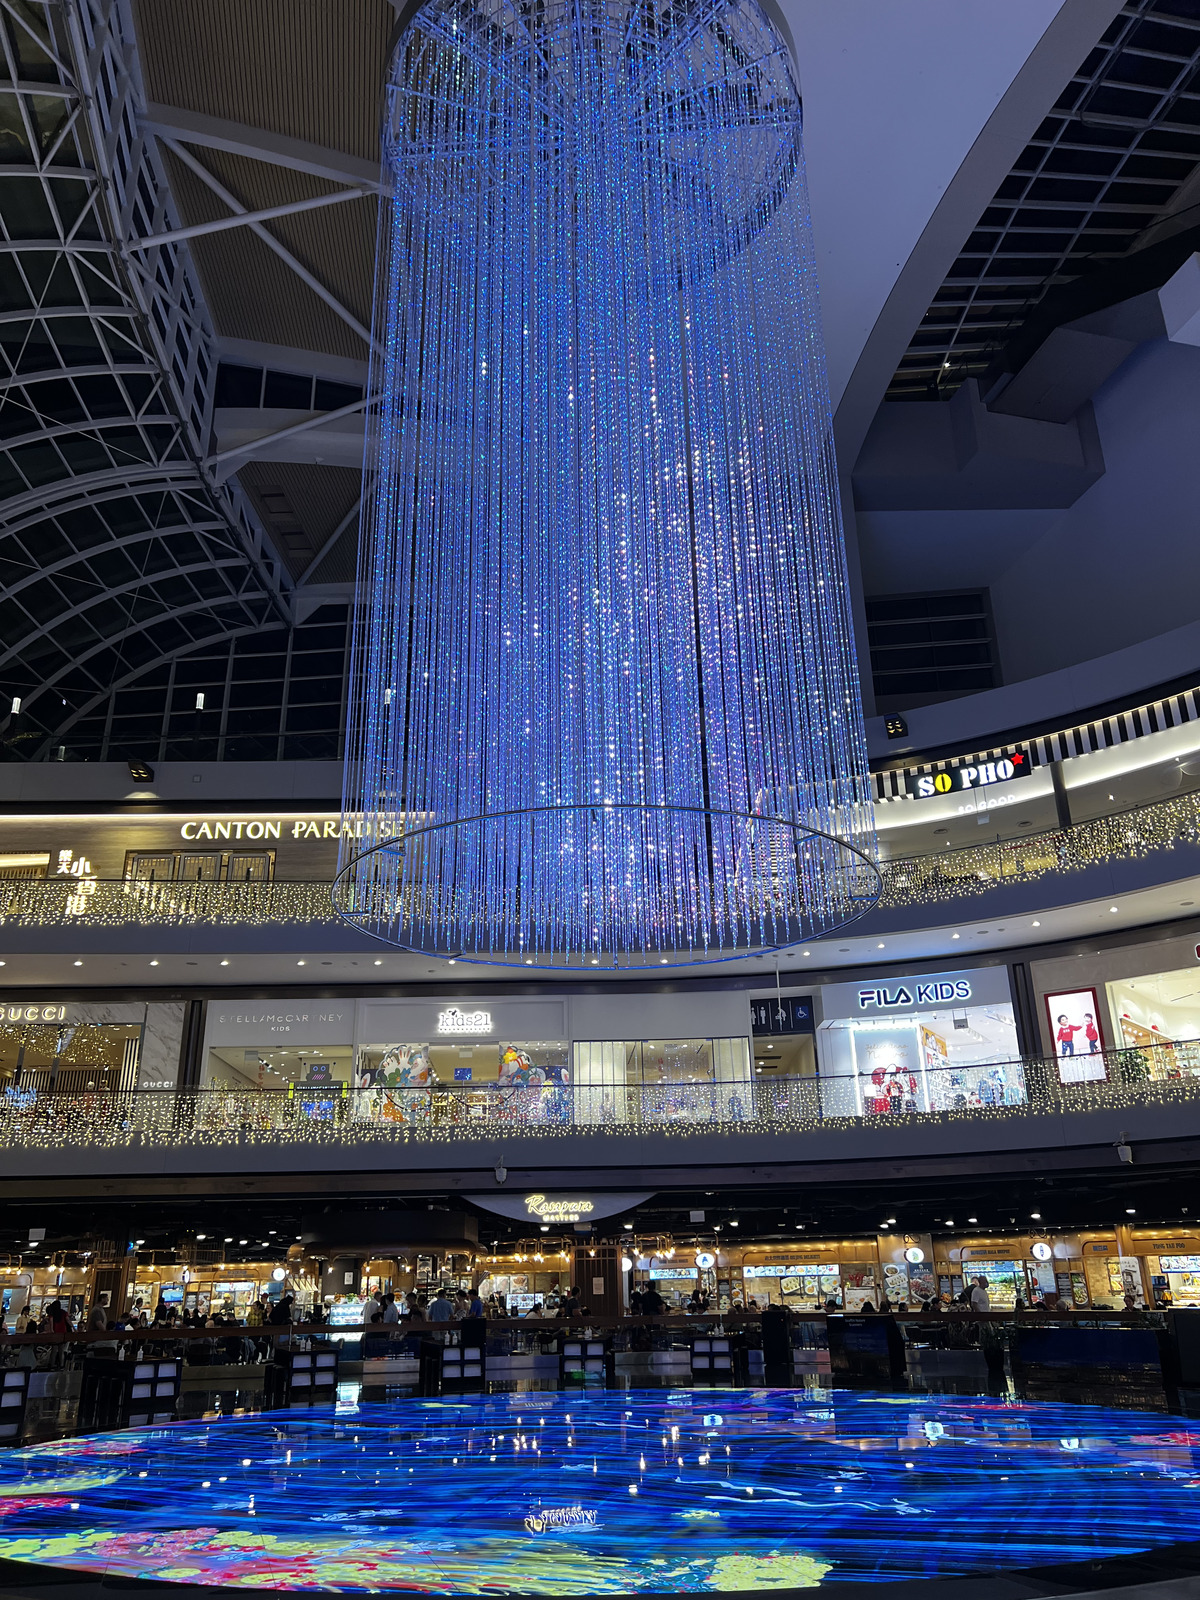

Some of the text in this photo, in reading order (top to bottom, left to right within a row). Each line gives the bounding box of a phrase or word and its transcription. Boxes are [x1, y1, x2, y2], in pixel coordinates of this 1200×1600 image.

[917, 758, 1015, 797] SO PHO
[180, 820, 405, 840] CANTON PARADSE
[859, 981, 970, 1008] FILA KIDS
[439, 1012, 492, 1028] kids21
[142, 1080, 174, 1088] GUCCI
[525, 1195, 594, 1215] Rasapura
